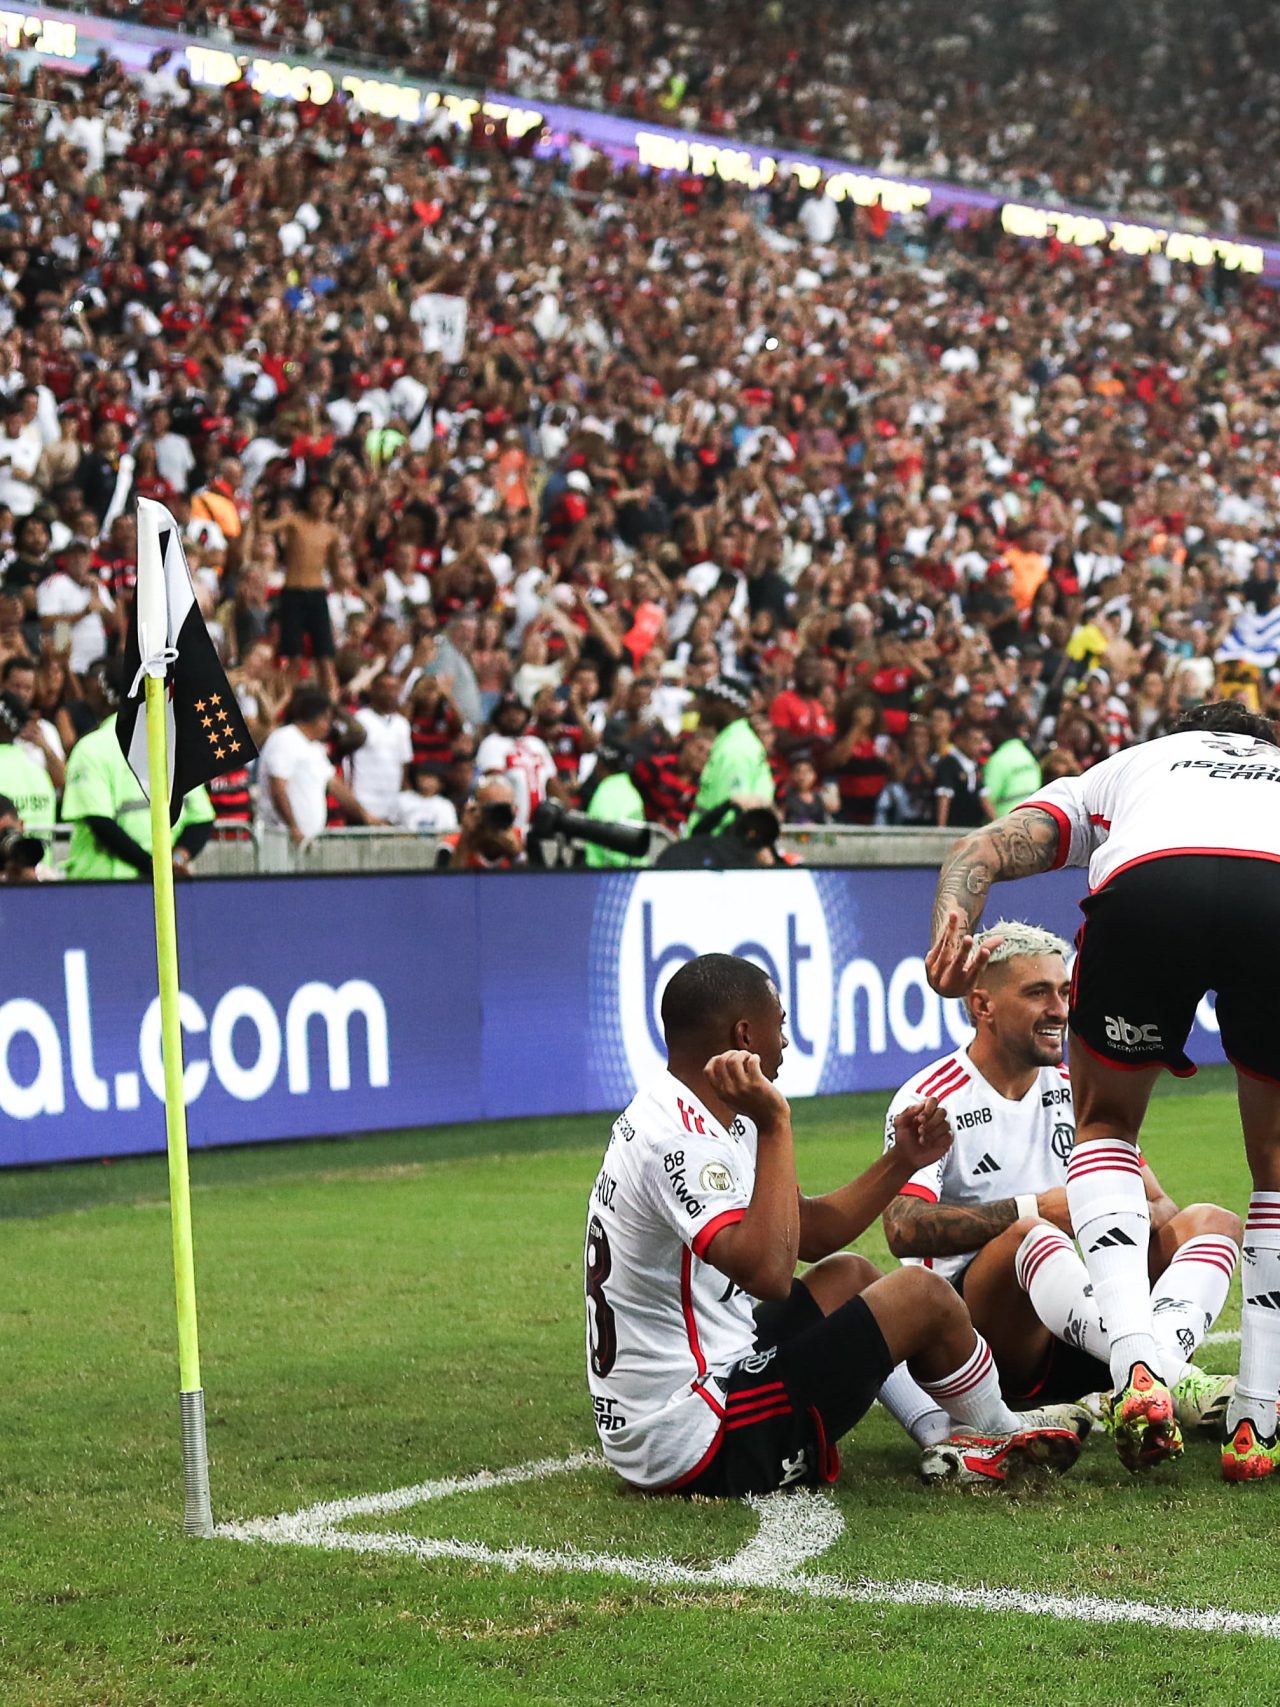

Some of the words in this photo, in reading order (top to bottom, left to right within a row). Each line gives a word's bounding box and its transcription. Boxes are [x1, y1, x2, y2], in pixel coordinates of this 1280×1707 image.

[1170, 760, 1280, 772] ASSIST
[1104, 1015, 1162, 1045] abc
[963, 1107, 993, 1128] BRB
